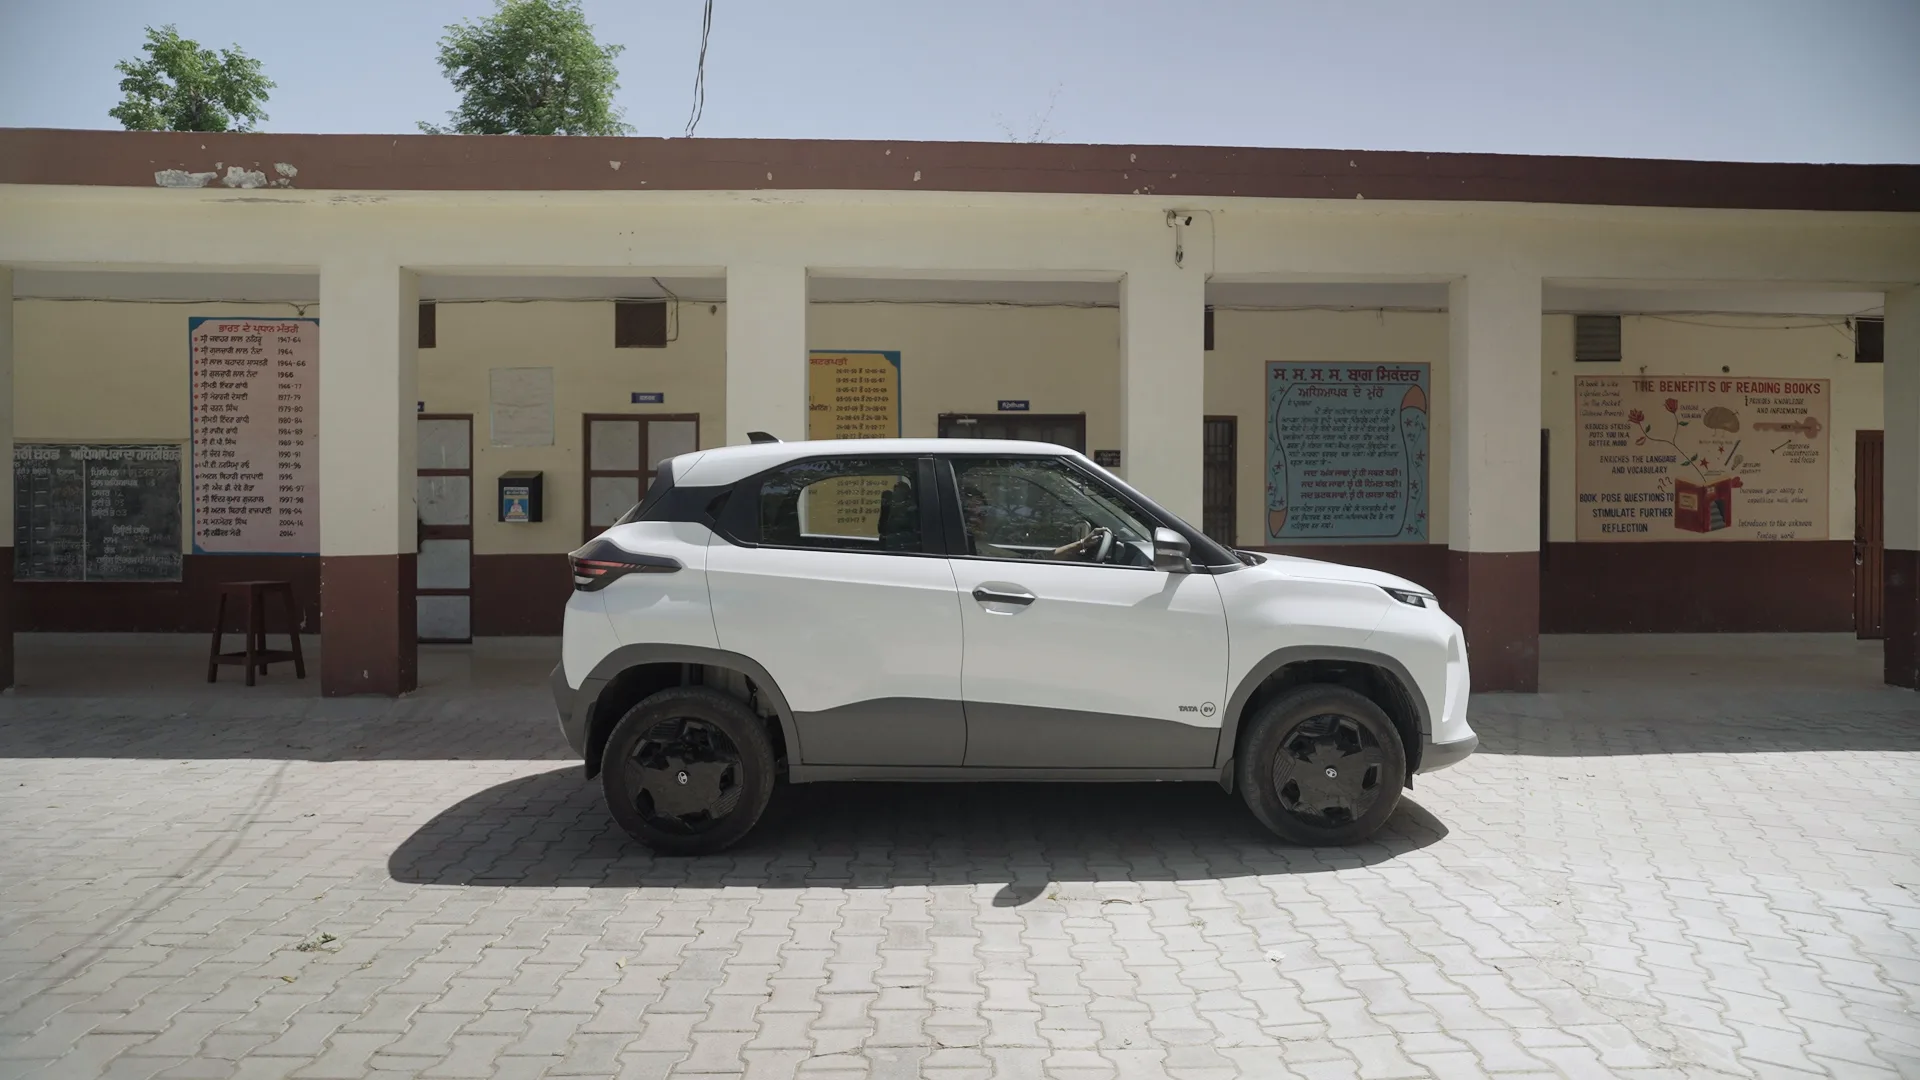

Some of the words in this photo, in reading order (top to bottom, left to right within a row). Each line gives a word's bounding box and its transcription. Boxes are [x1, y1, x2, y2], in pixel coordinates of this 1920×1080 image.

[219, 325, 241, 334] ਭਾਰਤ
[242, 323, 251, 334] ਦੇ
[253, 325, 275, 336] ਪ੍ਰਧਾਨ
[277, 336, 301, 344] 1947-64
[1347, 368, 1374, 382] ਬਾਗ
[1376, 365, 1421, 382] ਸਿਕੰਦਰ
[1297, 384, 1348, 398] ਅਧਿਆਪਕ
[1352, 385, 1362, 398] ਦੇ
[1632, 380, 1655, 392] THE
[1660, 380, 1716, 393] BENEFITS
[1720, 381, 1733, 393] OF
[1736, 381, 1780, 394] READING
[1784, 382, 1821, 394] BOOKS
[1774, 397, 1805, 405] KNOWLEDGE
[1757, 407, 1769, 415] AND
[1769, 407, 1808, 415] INFORMATION
[278, 450, 301, 458] 1990-91
[1600, 455, 1630, 463] ENRICHES
[1632, 455, 1643, 463] THE
[1645, 455, 1676, 463] LANGUAGE
[1611, 466, 1625, 474] AND
[1627, 466, 1668, 474] VOCABULARY
[279, 496, 304, 504] 1997-98
[1579, 493, 1597, 502] BOOK
[1601, 493, 1621, 502] POSE
[1624, 493, 1665, 502] QUESTIONS
[1666, 492, 1674, 501] TO
[279, 507, 303, 515] 1998-04
[1592, 508, 1636, 518] STIMULATE
[1639, 508, 1673, 518] FURTHER
[279, 519, 304, 527] 2004-14
[1602, 523, 1648, 533] REFLECTION
